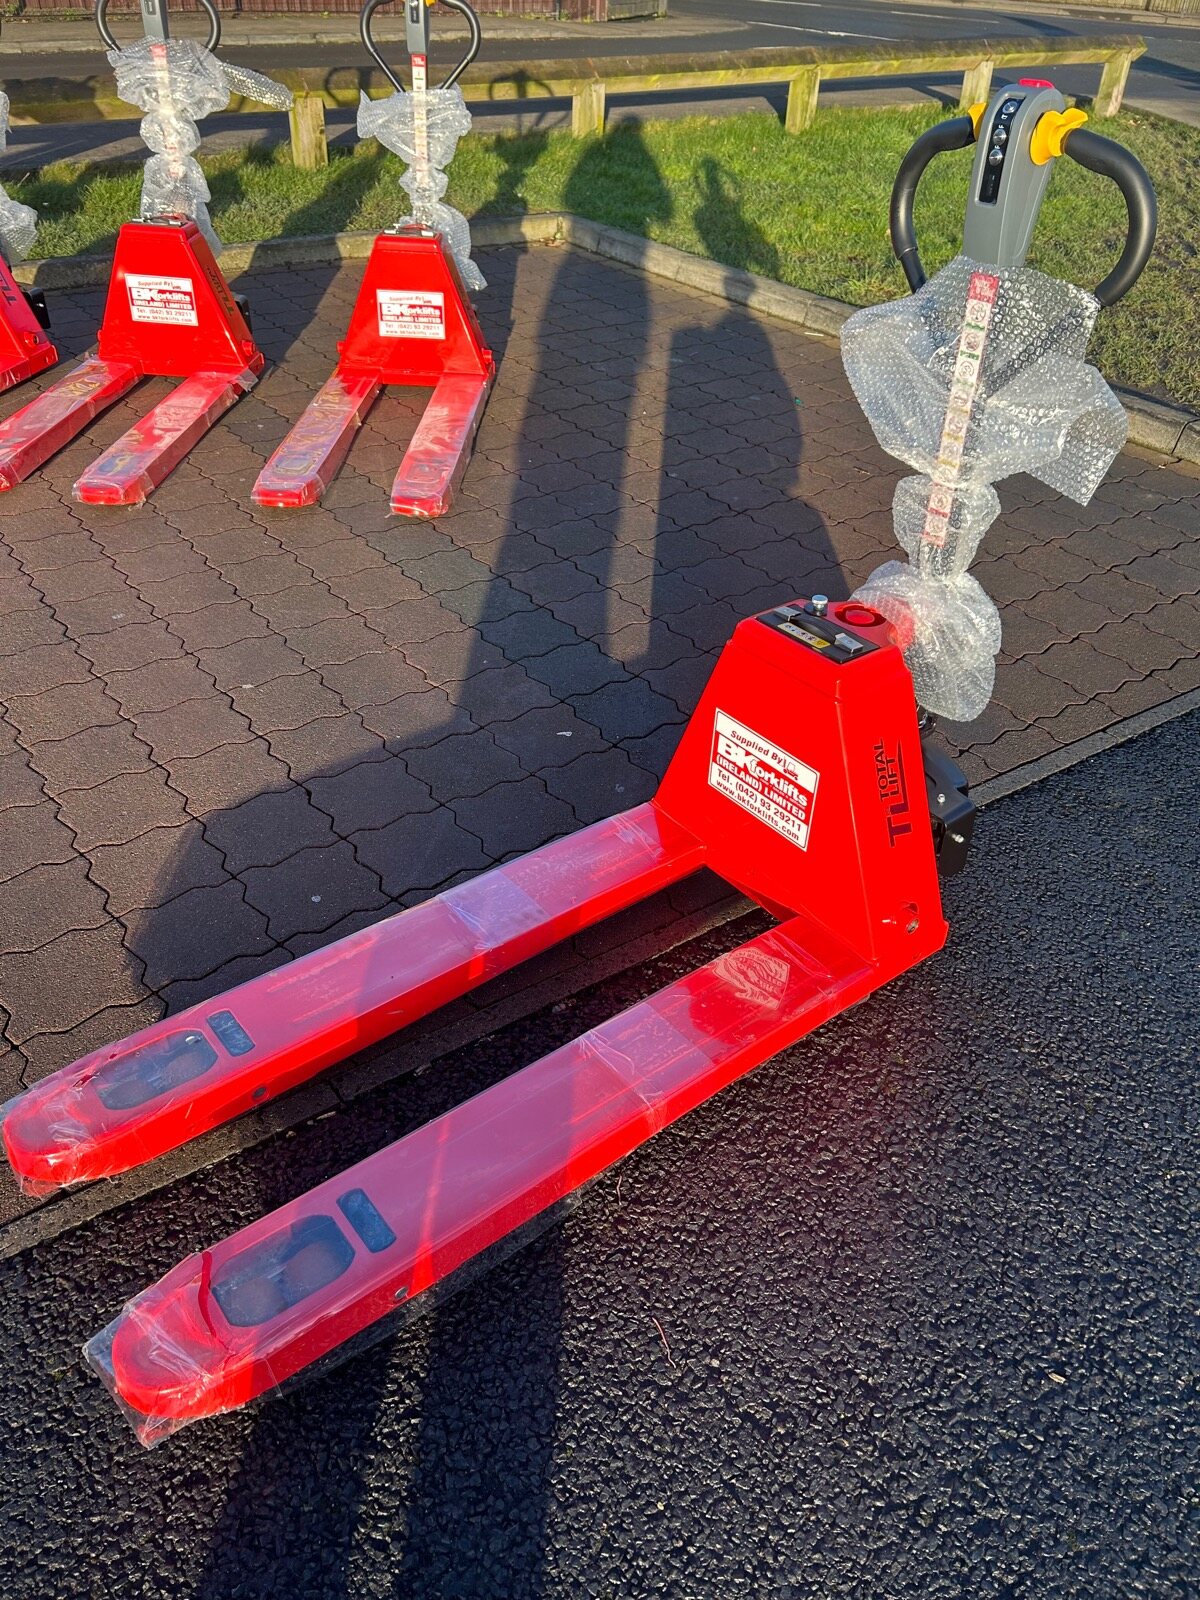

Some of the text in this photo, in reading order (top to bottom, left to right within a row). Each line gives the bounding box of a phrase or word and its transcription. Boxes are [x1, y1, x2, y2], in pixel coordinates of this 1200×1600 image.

[166, 302, 193, 310] LIMITED
[730, 730, 783, 765] Supplied By
[874, 737, 890, 802] TOTAL
[885, 756, 900, 797] LIFT
[716, 754, 806, 820] (IRELAND) LIMITED
[716, 780, 800, 841] www.bkforklifts.com
[717, 769, 802, 832] Tel. (042) 93 29211
